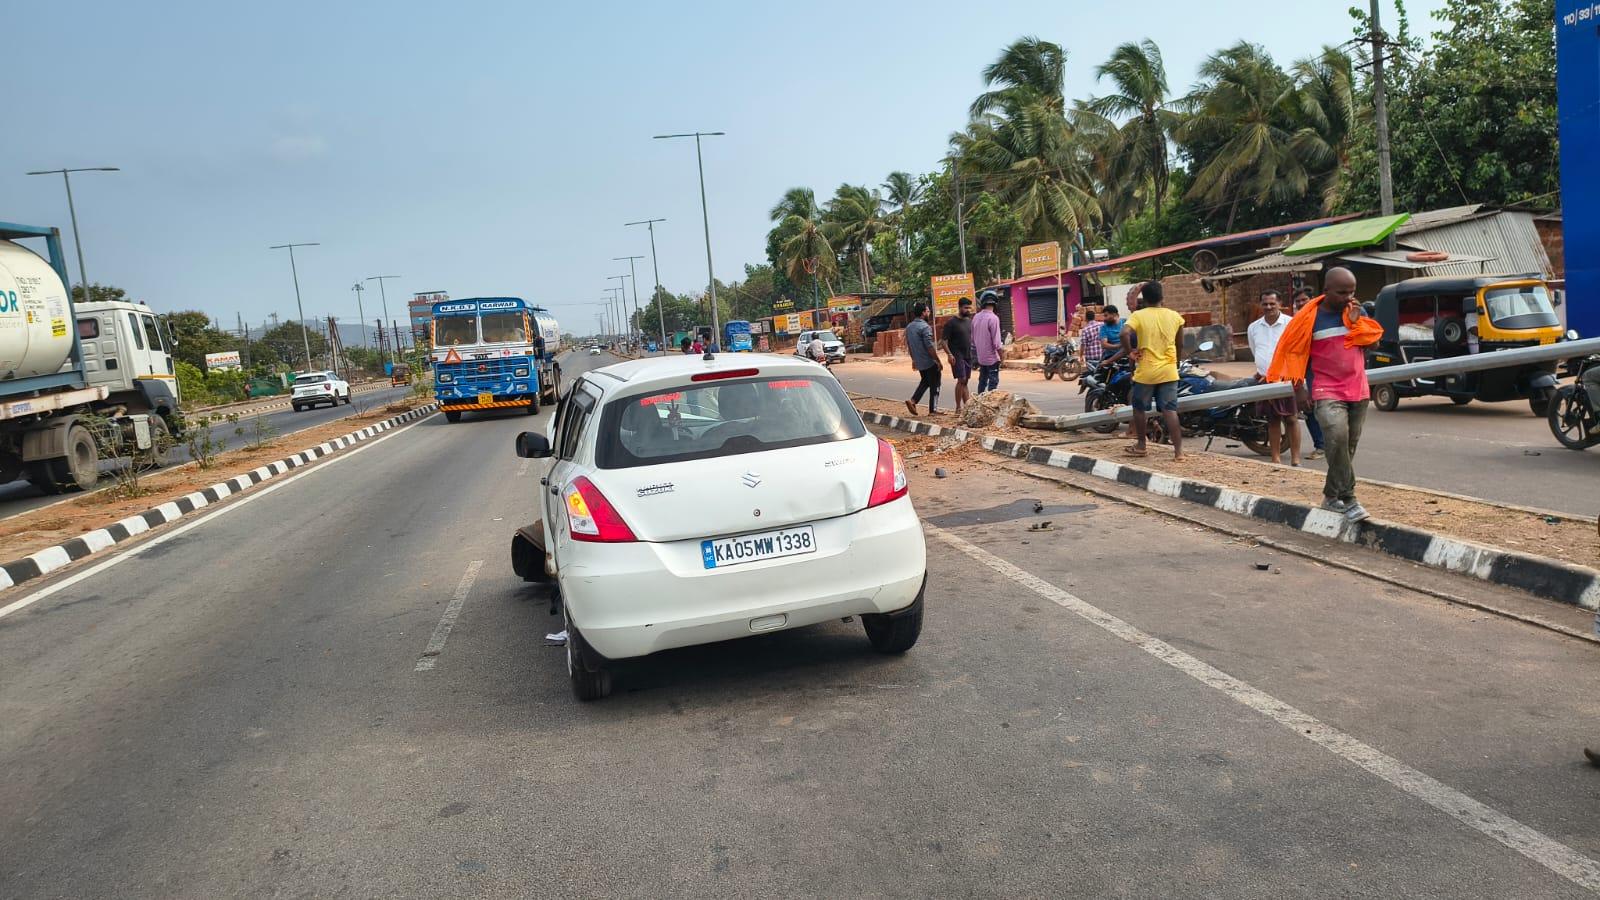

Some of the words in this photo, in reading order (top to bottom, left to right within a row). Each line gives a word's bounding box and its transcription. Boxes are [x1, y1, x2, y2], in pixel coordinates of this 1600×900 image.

[1025, 255, 1052, 263] HOTEL
[935, 274, 968, 282] HOTEL
[714, 532, 811, 561] KA05MW1338
